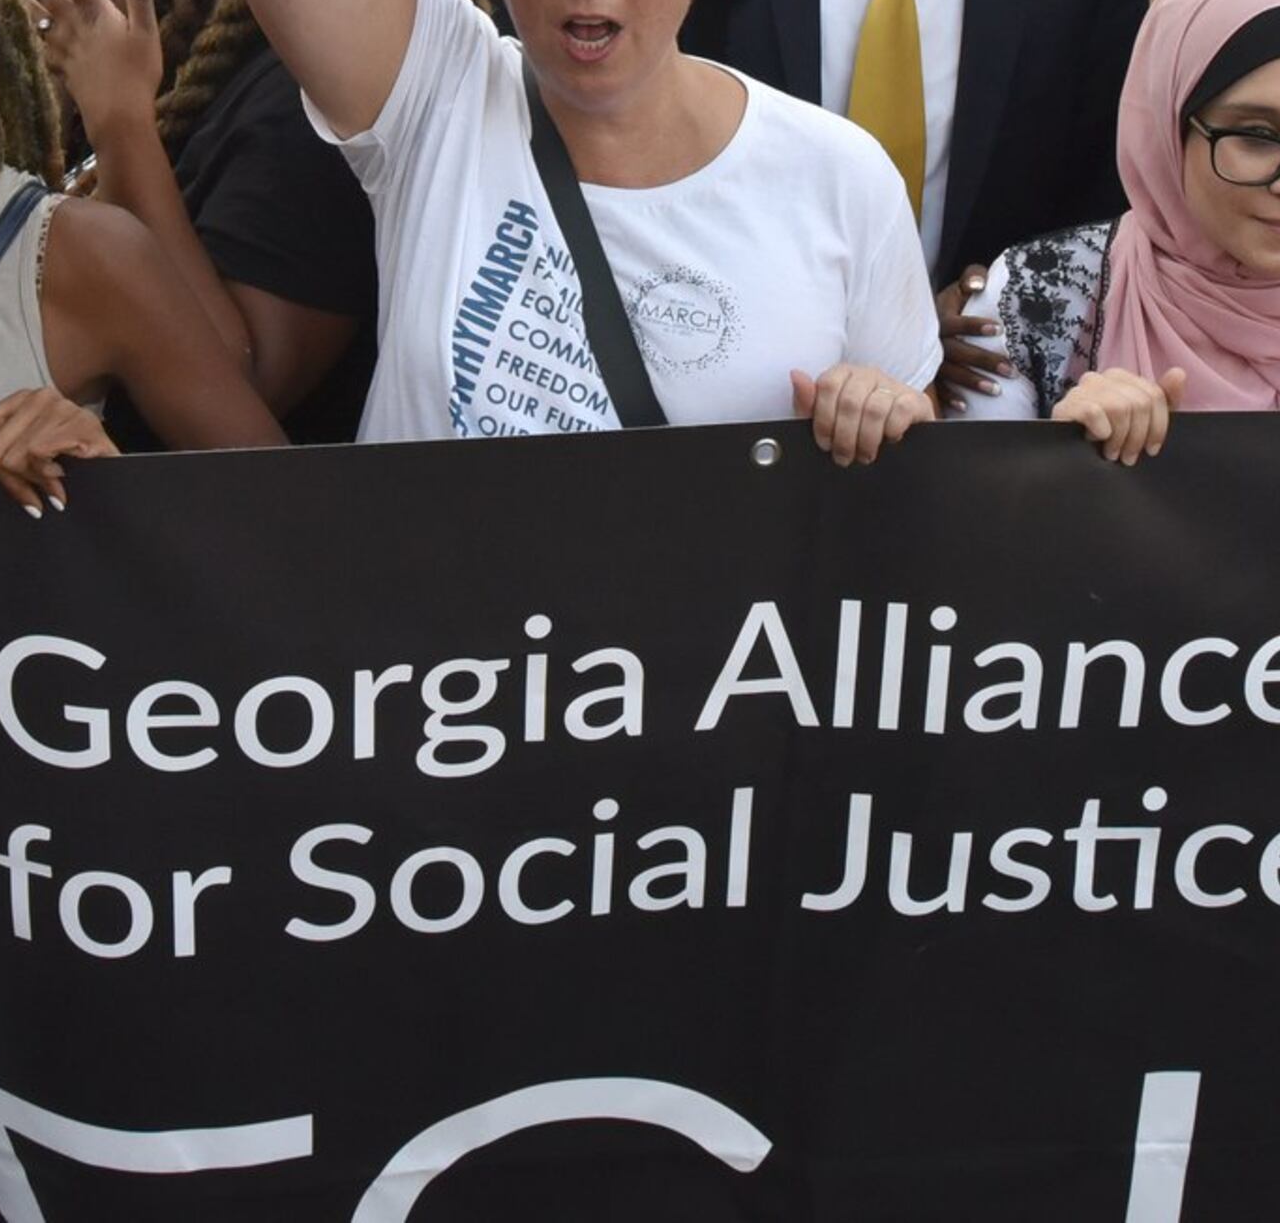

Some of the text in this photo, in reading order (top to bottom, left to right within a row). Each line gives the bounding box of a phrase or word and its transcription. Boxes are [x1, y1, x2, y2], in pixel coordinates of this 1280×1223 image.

[640, 302, 721, 331] MARCH
[486, 382, 539, 418] OUR
[495, 349, 609, 416] FREEDOM
[285, 788, 754, 942] Social
